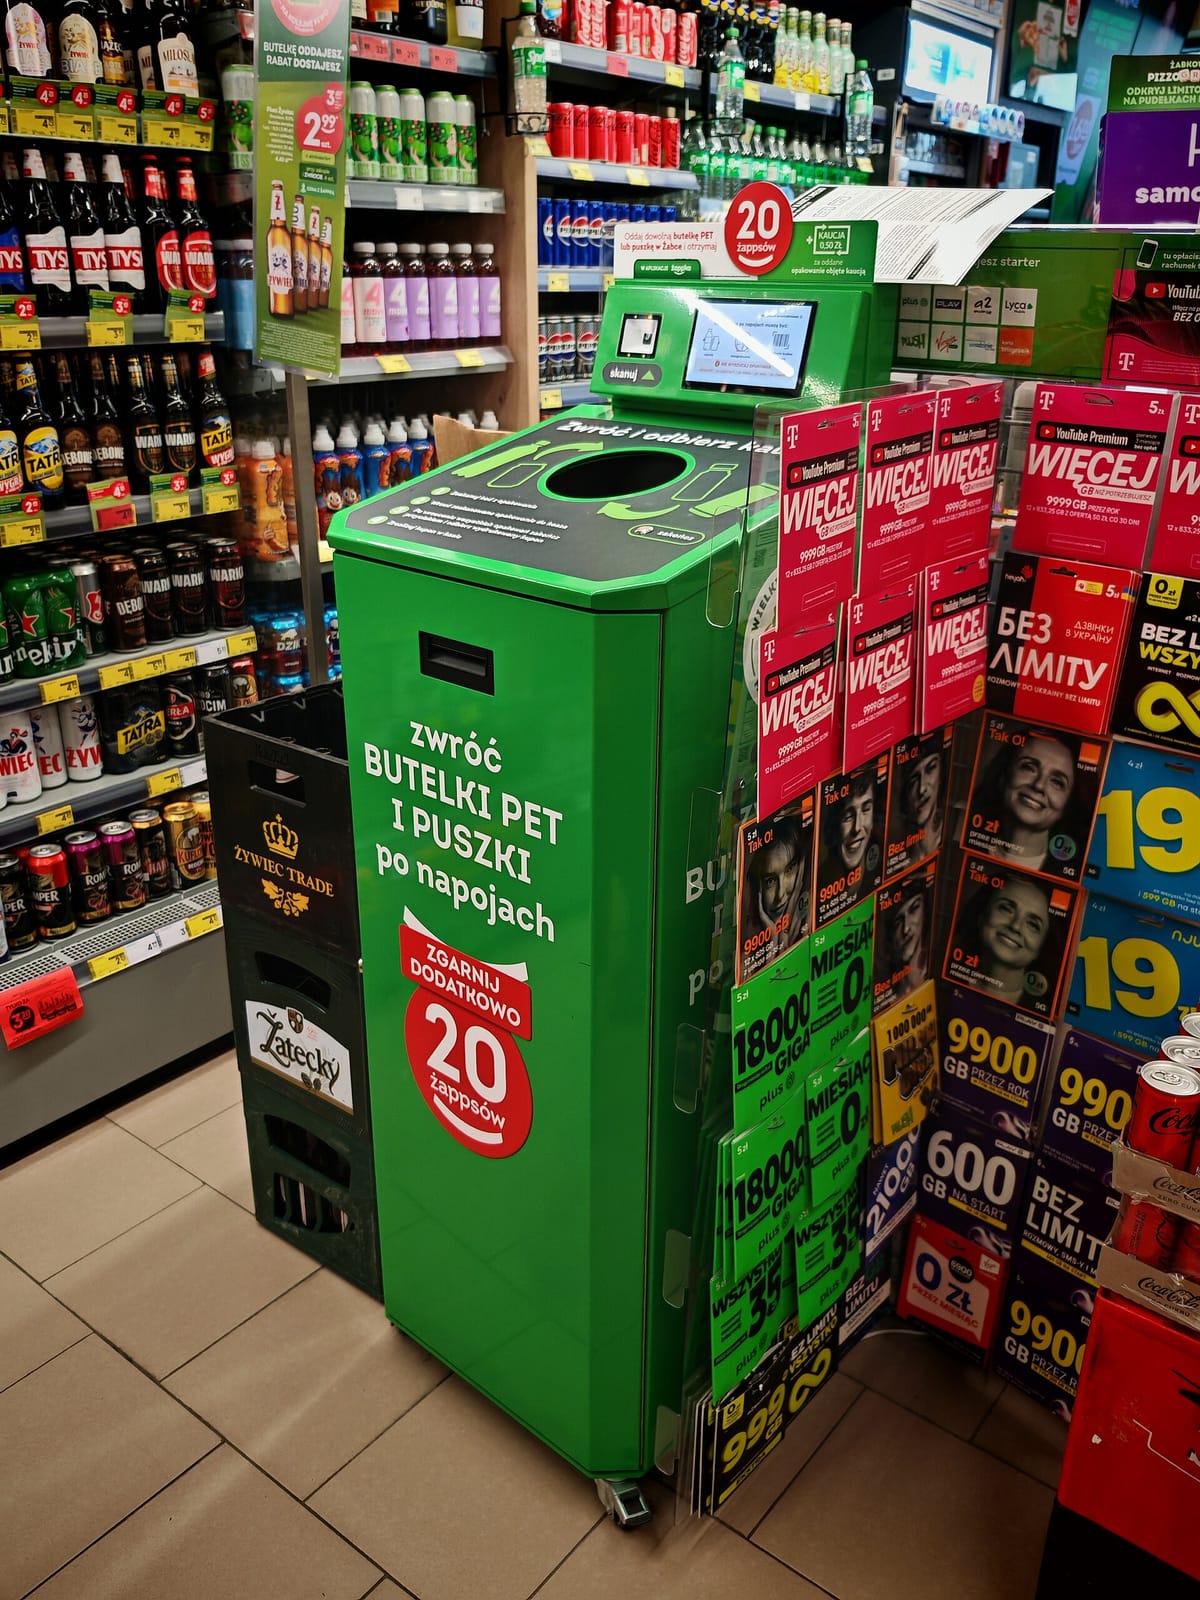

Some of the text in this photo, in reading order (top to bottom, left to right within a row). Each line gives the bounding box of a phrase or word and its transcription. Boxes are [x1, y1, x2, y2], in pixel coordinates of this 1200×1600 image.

[264, 42, 344, 61] BUTELKĘ ODDAJESZ,
[266, 55, 341, 72] RABAT DOSTAJESZ
[1124, 95, 1196, 105] NA PUDEŁKACH
[1126, 87, 1165, 96] ODKRYJ
[673, 231, 699, 242] butelkę
[700, 231, 714, 240] PET
[736, 200, 780, 240] 20
[818, 232, 846, 240] KAUCJA
[620, 242, 630, 250] lub
[632, 242, 654, 252] puszkę
[662, 240, 682, 250] Żabce
[687, 243, 717, 252] otrzymaj
[736, 242, 776, 255] żappsów
[1000, 258, 1040, 267] starter
[1005, 300, 1026, 311] Lyca
[1173, 312, 1193, 322] BEZ
[610, 368, 638, 382] skanuj
[556, 420, 632, 438] Zwróć
[630, 429, 646, 438] i
[642, 430, 737, 450] odbierz
[1056, 427, 1088, 442] YouTube
[1089, 430, 1128, 446] Premium
[866, 455, 932, 510] WIĘCEJ
[934, 442, 997, 490] WIĘCEJ
[1027, 443, 1159, 490] WIĘCEJ
[784, 474, 858, 534] WIĘCEJ
[1046, 496, 1120, 514] 9999 GB PRZEZ ROK
[1080, 486, 1094, 496] GB
[1128, 518, 1140, 526] DNI
[1155, 578, 1168, 594] 0
[928, 605, 988, 656] WIĘCEJ
[997, 606, 1052, 645] БЕЗ
[1072, 631, 1112, 645] УКРАЇНУ
[1074, 620, 1114, 634] ДЗВІНКИ
[1140, 622, 1186, 646] BEZ
[850, 633, 912, 694] WIĘCEJ
[762, 666, 834, 737] WIĘCEJ
[987, 675, 1101, 706] ROZMOWY DO UKRAINY BEZ LIMITU
[123, 714, 162, 745] TATRA
[410, 720, 502, 773] zwróć
[990, 728, 1026, 748] Tak O!
[364, 742, 562, 845] BUTELKI PET
[392, 798, 531, 884] I PUSZKI
[972, 814, 1000, 834] 0 zł
[1098, 786, 1200, 874] 19
[748, 829, 774, 854] Tak O!
[234, 844, 335, 898] ŻYWIEC TRADE
[820, 866, 862, 903] 9900 GB
[970, 869, 1006, 890] Tak O!
[376, 843, 554, 942] po napojach
[1142, 892, 1160, 904] 599
[1162, 896, 1176, 908] GB
[744, 913, 790, 956] 9900 GB
[426, 944, 500, 994] ZGARNIJ
[952, 948, 980, 968] 0 zł
[410, 958, 521, 1027] DODATKOWO
[1077, 936, 1180, 1018] 19
[734, 980, 810, 1076] 18000
[425, 1002, 506, 1104] 20
[774, 1028, 810, 1076] GIGA
[947, 1017, 1038, 1085] 9900
[943, 1055, 970, 1080] GB
[970, 1066, 1006, 1092] PRZEZ
[1006, 1083, 1030, 1100] ROK
[430, 1072, 506, 1130] żappsów
[760, 1082, 784, 1112] plus
[1052, 1108, 1080, 1136] GB
[927, 1130, 1016, 1207] 600
[922, 1172, 1006, 1222] GB NA START
[1032, 1175, 1084, 1224] BEZ
[844, 1278, 880, 1318] LIMITU
[845, 1276, 864, 1300] BEZ
[916, 1252, 975, 1317] 0 ZŁ
[1004, 1336, 1030, 1365] GB
[1032, 1352, 1068, 1384] PRZEZ
[722, 1382, 786, 1474] 999
[765, 1414, 782, 1442] GB
